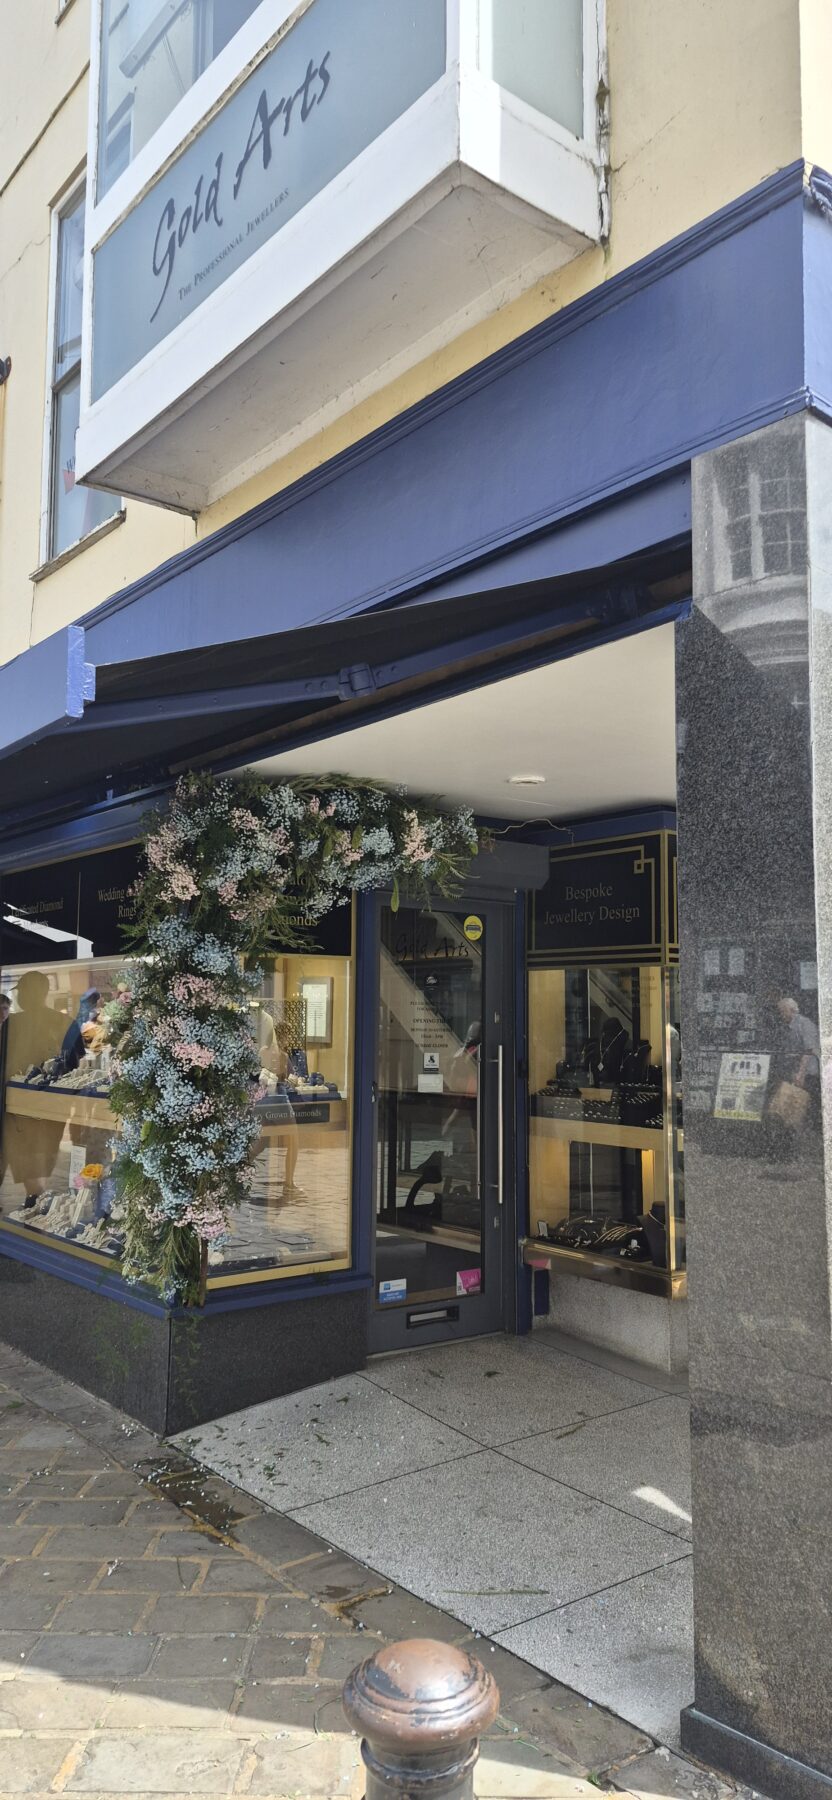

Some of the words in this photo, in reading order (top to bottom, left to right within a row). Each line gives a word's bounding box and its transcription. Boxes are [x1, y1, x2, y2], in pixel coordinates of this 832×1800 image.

[149, 151, 224, 323] Gold
[233, 50, 331, 200] Arts
[98, 887, 125, 902] Wedding
[565, 883, 613, 901] Bespoke
[118, 904, 137, 919] Rings
[543, 907, 594, 925] Jewellery
[599, 904, 640, 923] Design
[434, 937, 469, 958] Arts
[265, 1111, 288, 1120] Grown
[290, 1108, 322, 1118] Diamonds
